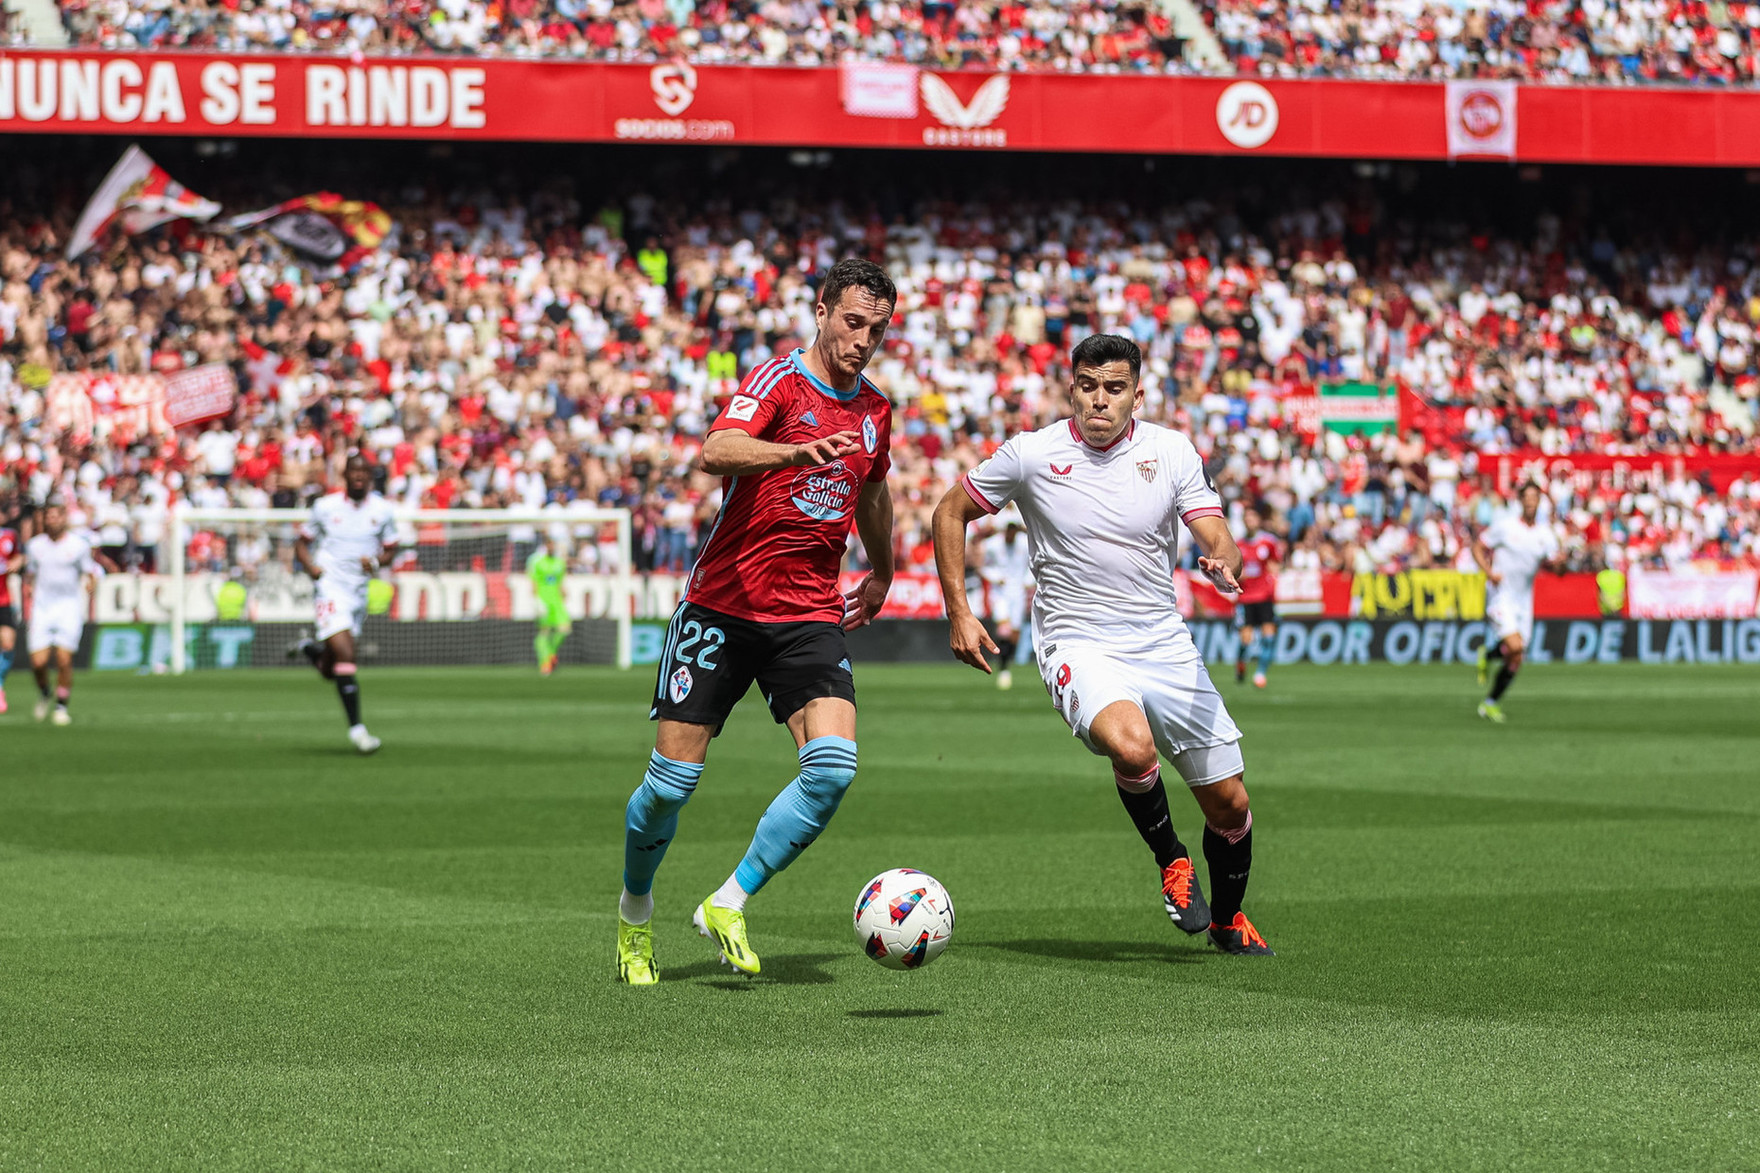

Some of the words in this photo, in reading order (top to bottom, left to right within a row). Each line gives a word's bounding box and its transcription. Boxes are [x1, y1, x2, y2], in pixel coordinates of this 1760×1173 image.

[201, 61, 277, 125] SE
[305, 65, 487, 128] RINDE
[1229, 101, 1267, 128] JD
[802, 486, 844, 509] Galicia
[806, 474, 851, 496] Estrella
[675, 620, 726, 671] 22
[1563, 620, 1627, 664] DE
